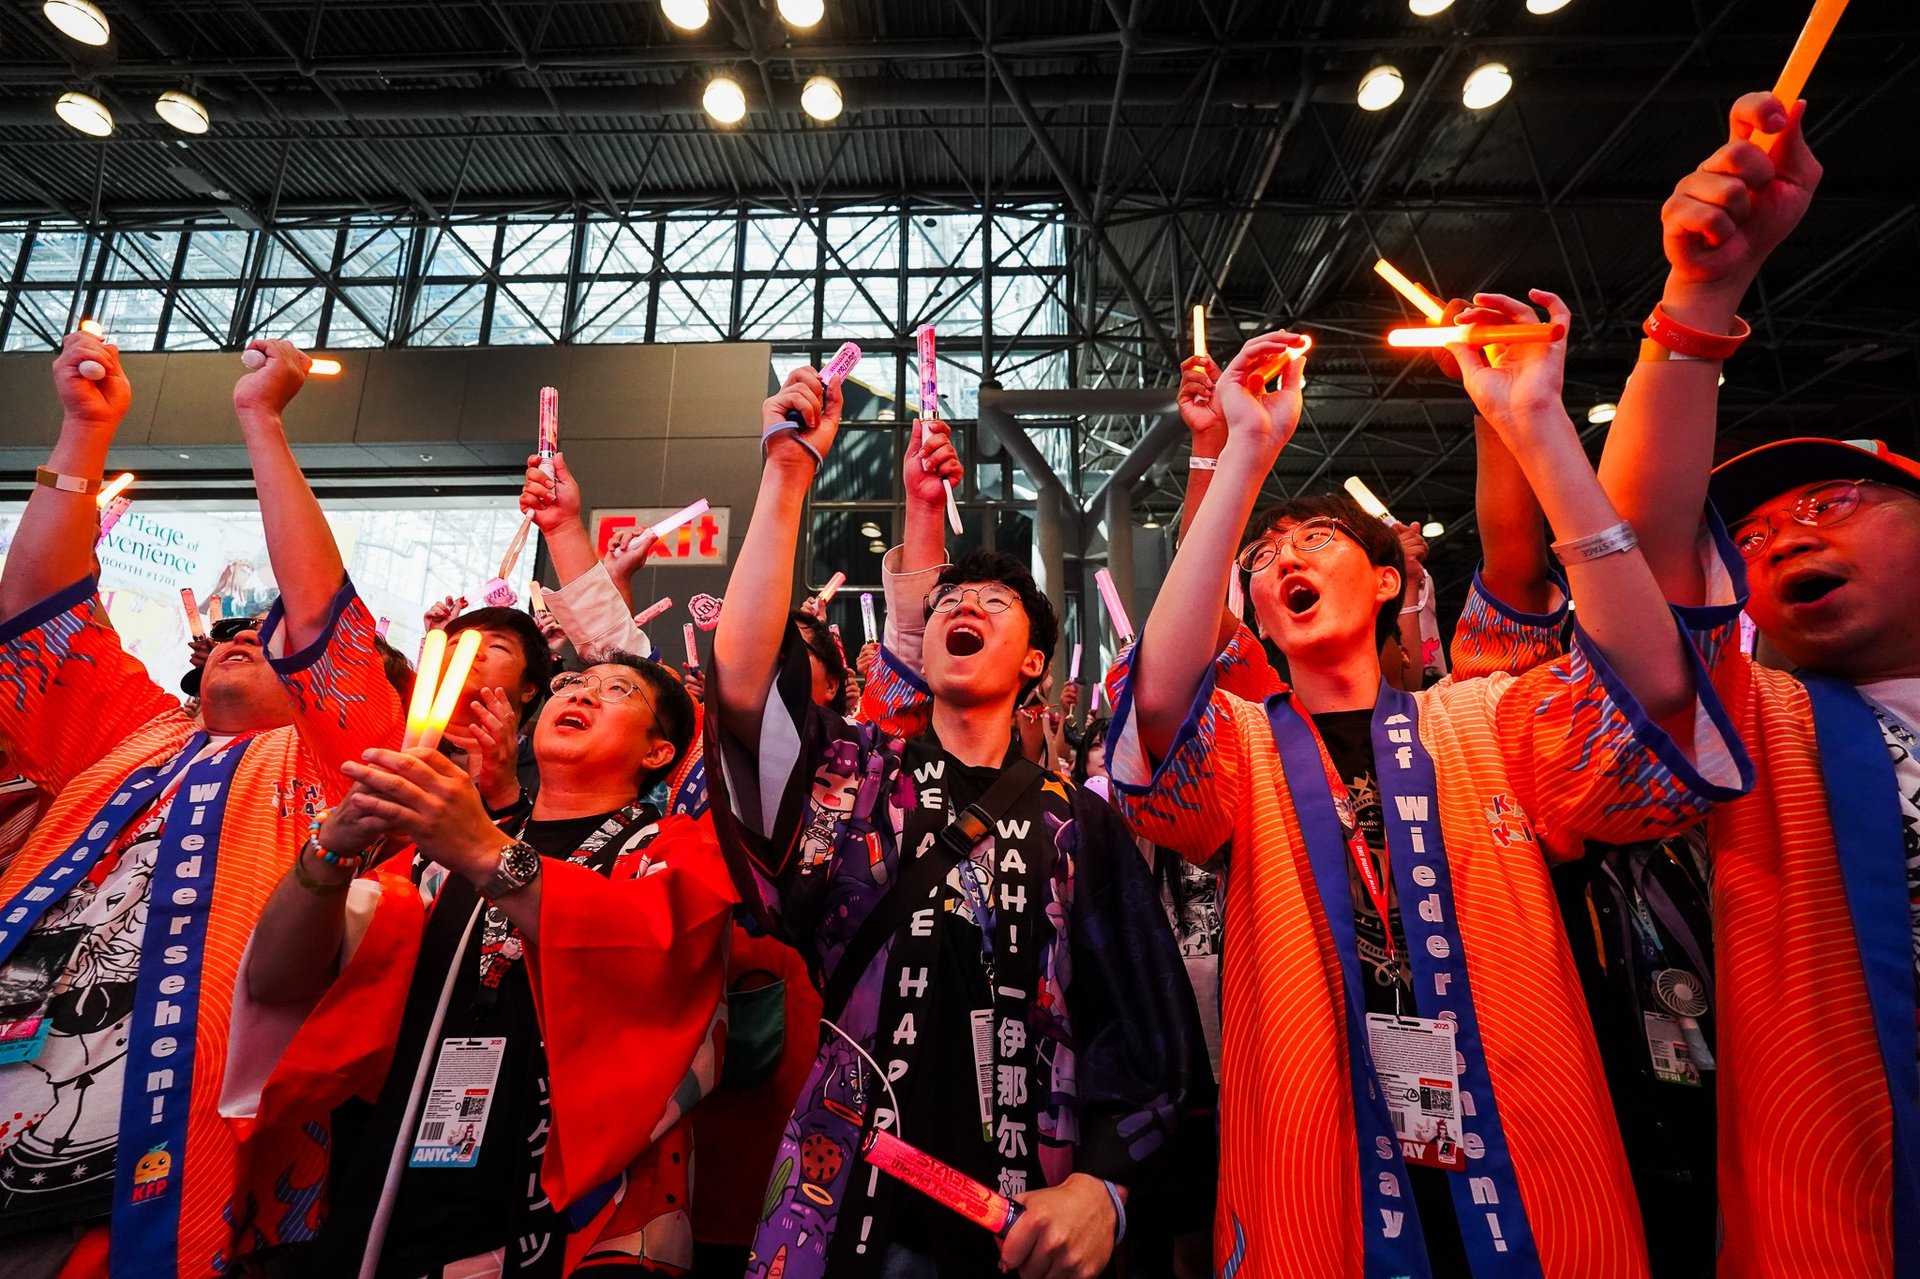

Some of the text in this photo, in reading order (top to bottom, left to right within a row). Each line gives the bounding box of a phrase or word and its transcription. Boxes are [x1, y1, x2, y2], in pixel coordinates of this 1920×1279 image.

[117, 511, 184, 548] riage
[101, 532, 196, 575] venience
[101, 556, 143, 576] BOOTH
[914, 760, 945, 810] WE
[911, 832, 936, 936] AE
[996, 819, 1031, 953] WAH!
[146, 782, 222, 1125] Wiedersehen!
[1401, 1146, 1427, 1160] AY
[132, 1179, 168, 1202] KFP
[1375, 1136, 1404, 1239] say
